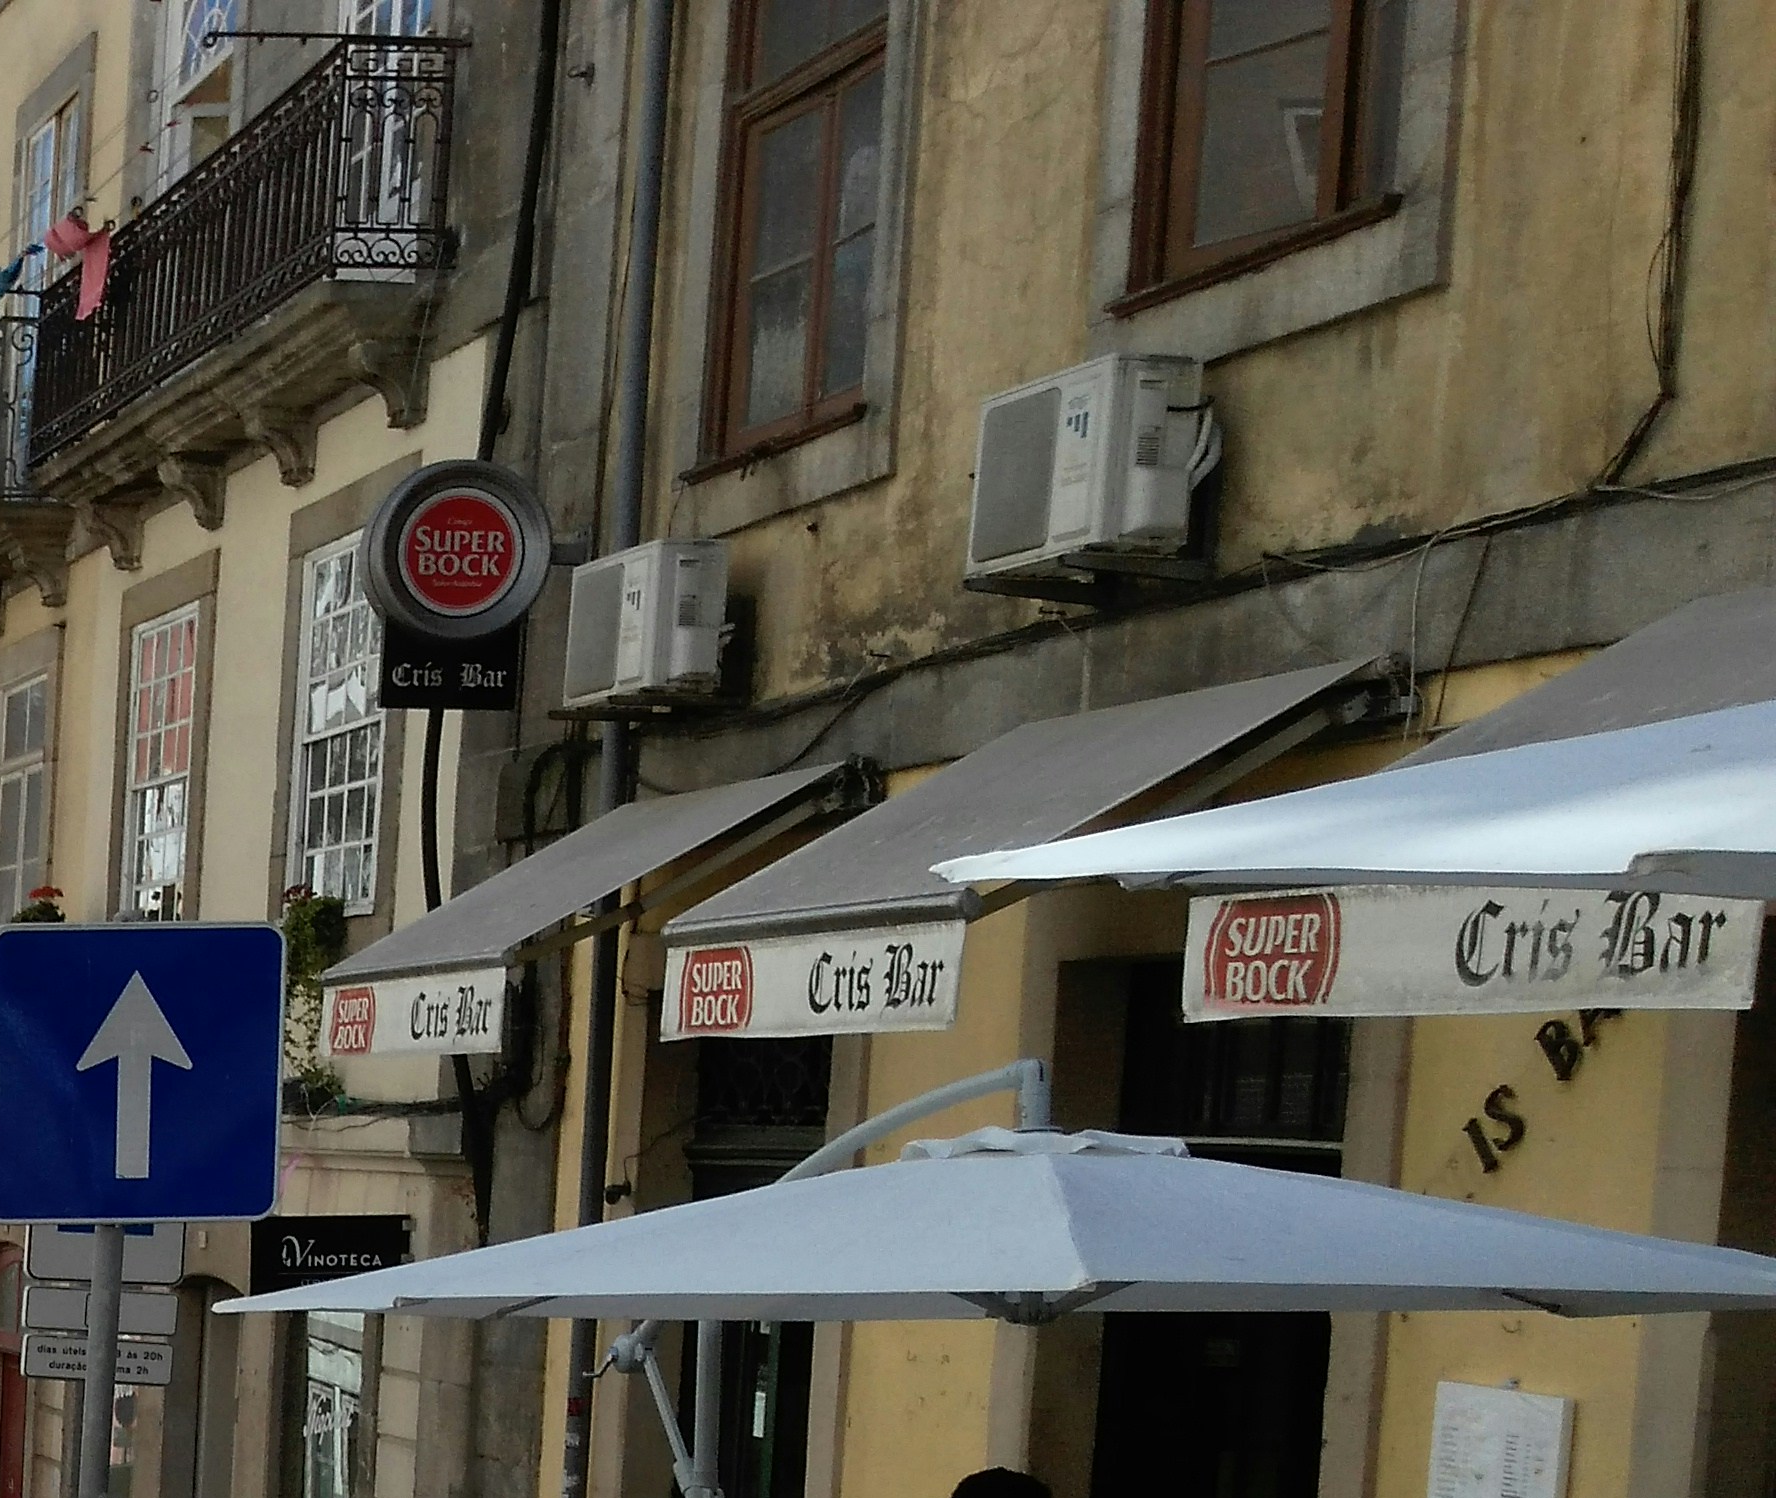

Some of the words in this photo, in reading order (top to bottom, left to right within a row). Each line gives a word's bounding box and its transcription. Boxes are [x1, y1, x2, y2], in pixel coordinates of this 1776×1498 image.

[414, 525, 505, 553] SUPER
[417, 553, 502, 577] BOCK
[391, 661, 443, 688] Cris
[459, 662, 508, 689] Bar
[1224, 912, 1321, 959] SUPER
[1454, 898, 1580, 987] Cris
[1597, 891, 1729, 979] Bar
[691, 959, 743, 993] SUPER
[808, 950, 874, 1015] Cris
[881, 942, 945, 1013] Bar
[1224, 958, 1313, 1003] BOCK
[338, 998, 369, 1023] SUPER
[410, 991, 451, 1041] Cris
[453, 985, 492, 1041] Bar
[690, 994, 740, 1026] BOCK
[333, 1024, 366, 1049] BOCK
[37, 1344, 57, 1354] dias
[143, 1351, 163, 1361] 20h
[136, 1366, 149, 1375] 2h
